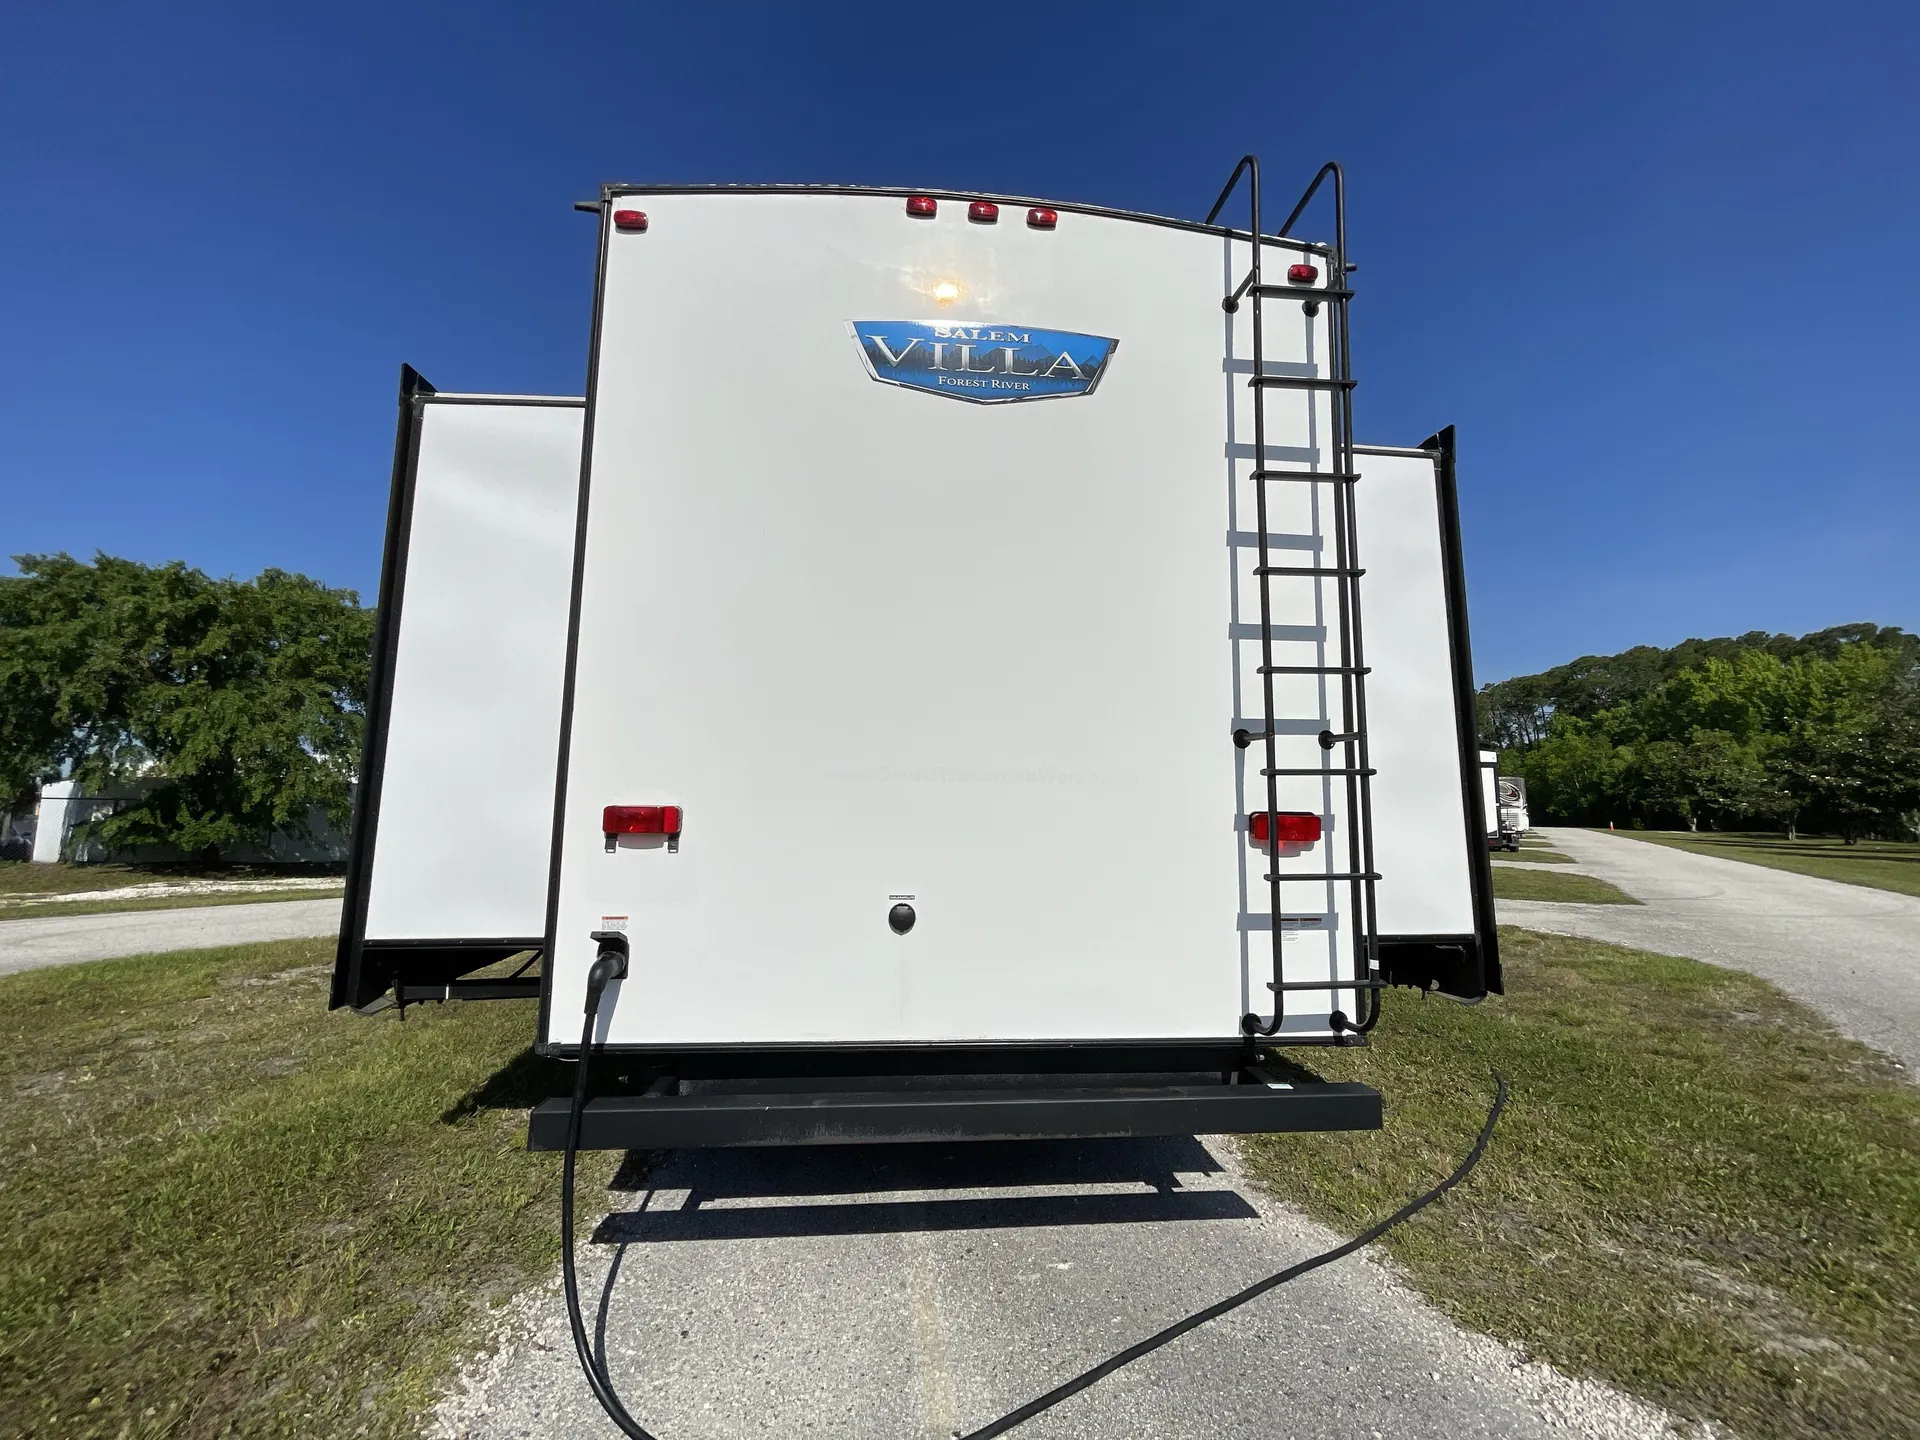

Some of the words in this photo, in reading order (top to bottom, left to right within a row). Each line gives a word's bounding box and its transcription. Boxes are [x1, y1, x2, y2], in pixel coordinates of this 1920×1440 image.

[934, 327, 1032, 343] SALEM
[865, 334, 1090, 379] VILLA
[938, 375, 988, 388] FOREST
[991, 379, 1031, 391] RIVER
